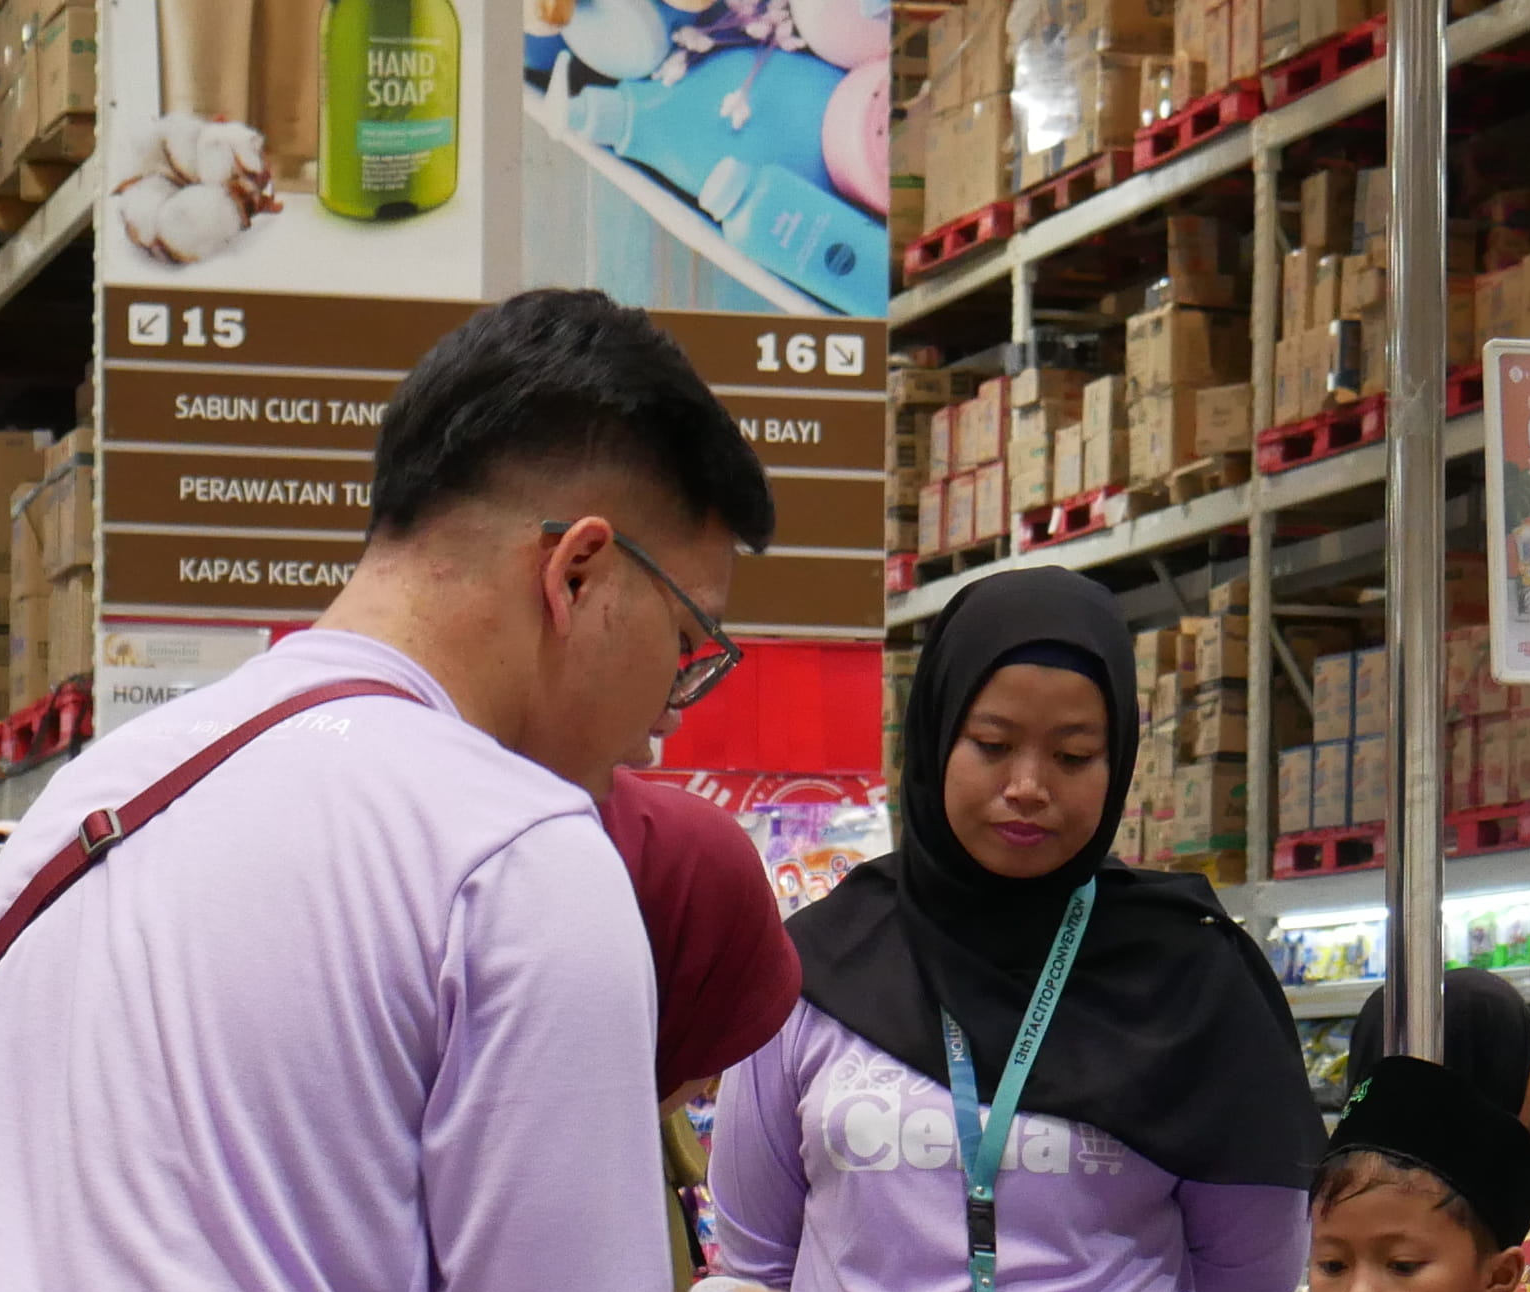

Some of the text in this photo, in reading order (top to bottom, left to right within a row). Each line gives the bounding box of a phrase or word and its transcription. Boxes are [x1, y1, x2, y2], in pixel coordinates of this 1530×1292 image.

[368, 50, 436, 77] HAND
[367, 79, 435, 106] SOAP
[181, 306, 245, 348] 15
[756, 332, 816, 374] 16
[175, 394, 258, 422] SABUN
[266, 398, 319, 425] CUCI
[762, 419, 820, 445] BAYI
[180, 478, 334, 508] PERAWATAN
[180, 557, 263, 586] KAPAS
[1049, 897, 1086, 981] CONVENTION
